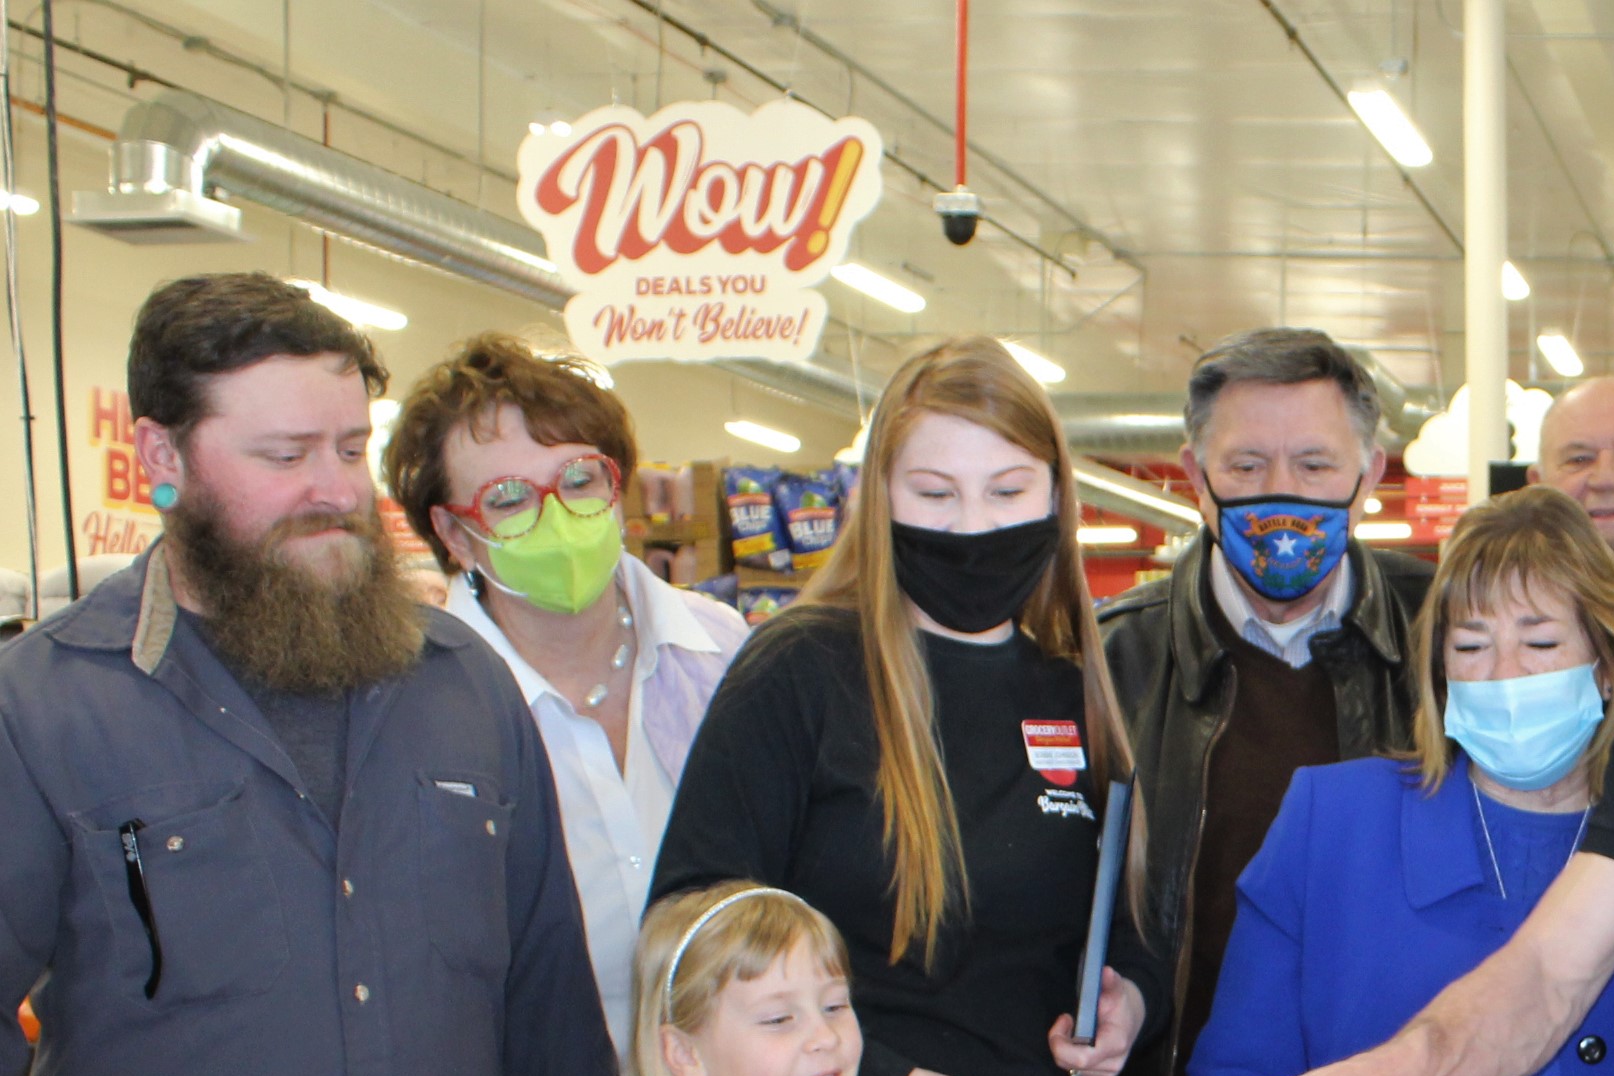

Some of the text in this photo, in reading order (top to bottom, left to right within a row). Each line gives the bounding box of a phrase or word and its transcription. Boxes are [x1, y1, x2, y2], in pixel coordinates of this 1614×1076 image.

[539, 120, 863, 273] Wow!
[636, 275, 767, 297] DEALS YOU
[593, 302, 811, 347] Won't Believe!
[730, 504, 772, 526] BLUE
